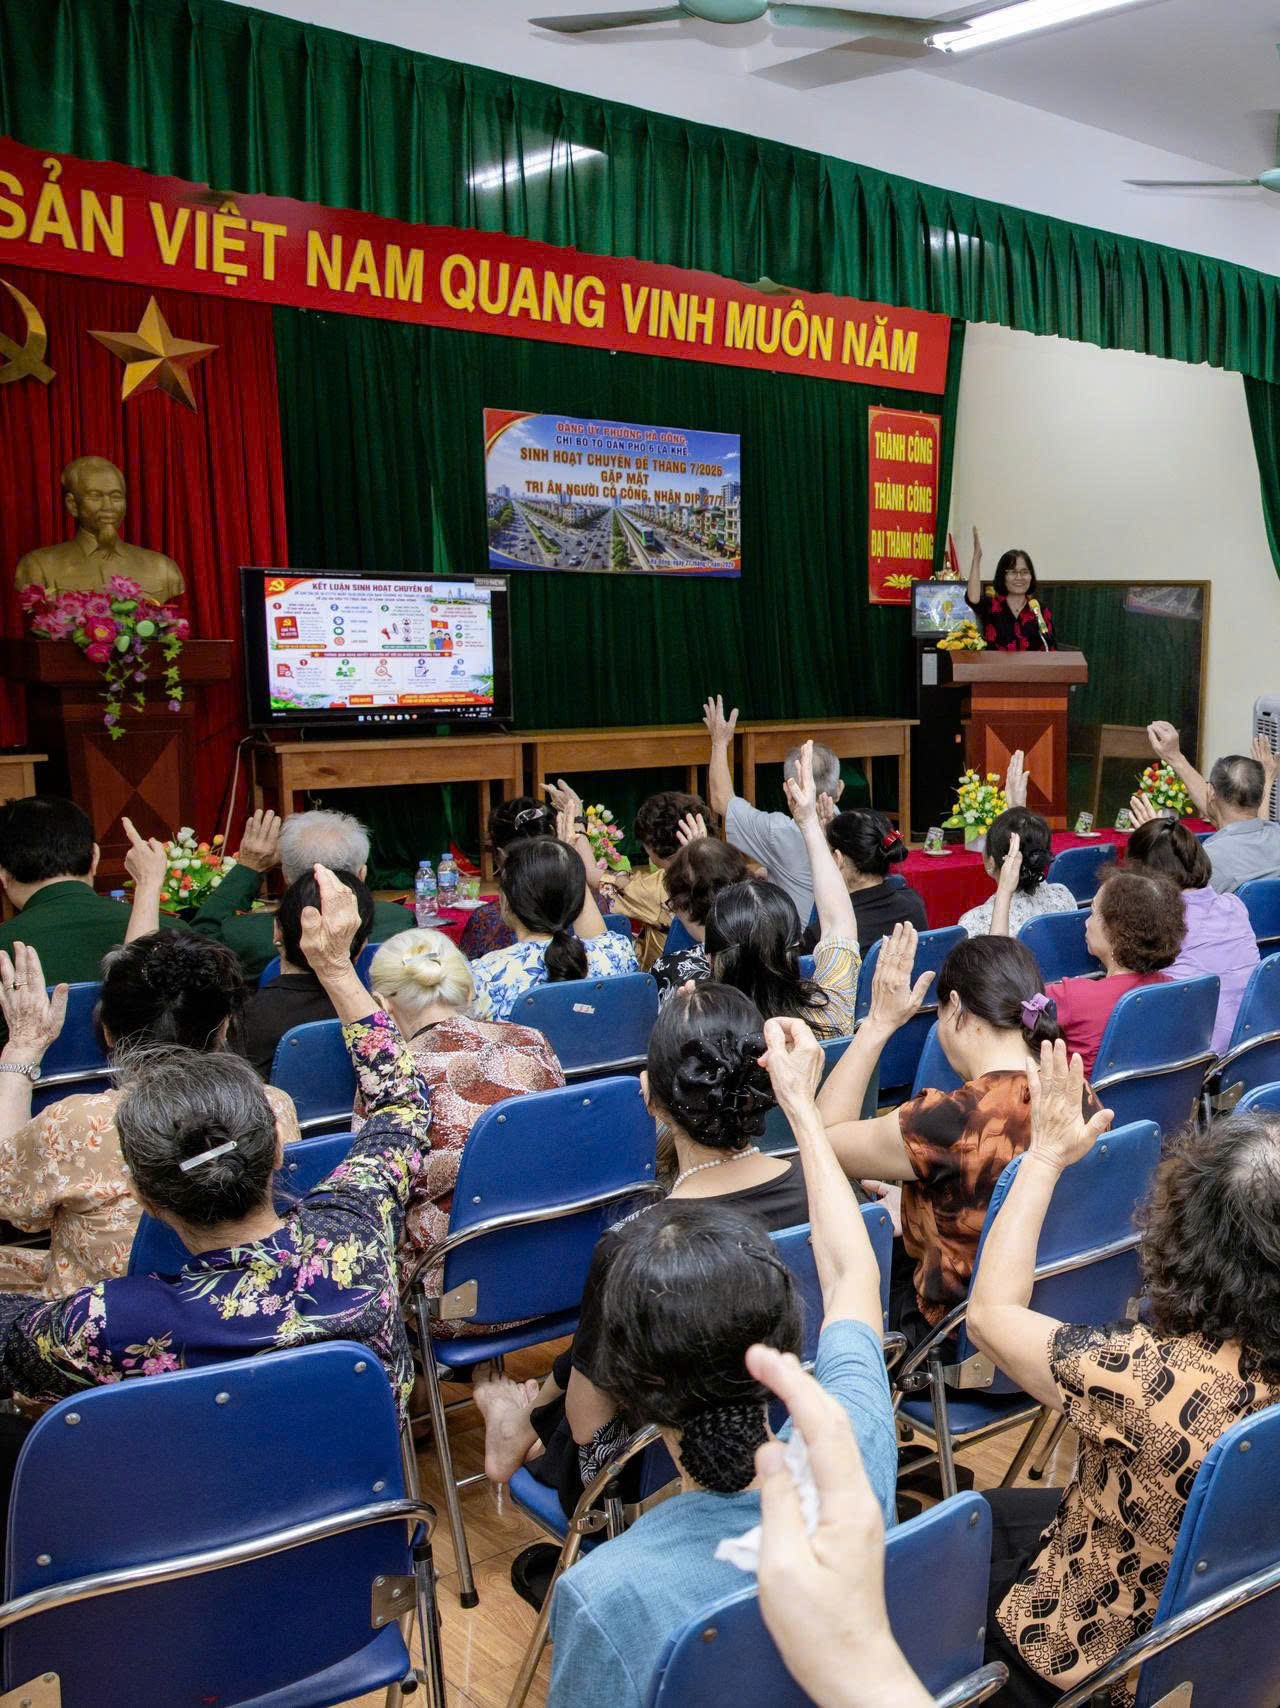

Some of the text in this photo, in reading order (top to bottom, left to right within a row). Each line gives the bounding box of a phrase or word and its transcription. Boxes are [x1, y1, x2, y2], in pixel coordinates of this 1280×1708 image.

[0, 158, 918, 374] SẢN VIỆT NAM QUANG VINH MUÔN NĂM
[556, 435, 572, 445] CHI
[657, 445, 668, 454] LA
[875, 427, 933, 464] THÀNH CÔNG
[520, 447, 549, 462] SINH
[553, 449, 583, 467] HOẠT
[587, 451, 631, 469] CHUYÊN
[635, 455, 649, 470] ĐỀ
[653, 457, 687, 474] THÁNG
[525, 480, 544, 493] TRI
[547, 479, 563, 494] ÂN
[566, 483, 599, 497] NGƯỜI
[601, 468, 650, 487] GẶP MẶT
[874, 477, 932, 513] THÀNH CÔNG
[871, 525, 934, 563] ĐẠI THÀNH CÔNG
[352, 583, 371, 592] SINH
